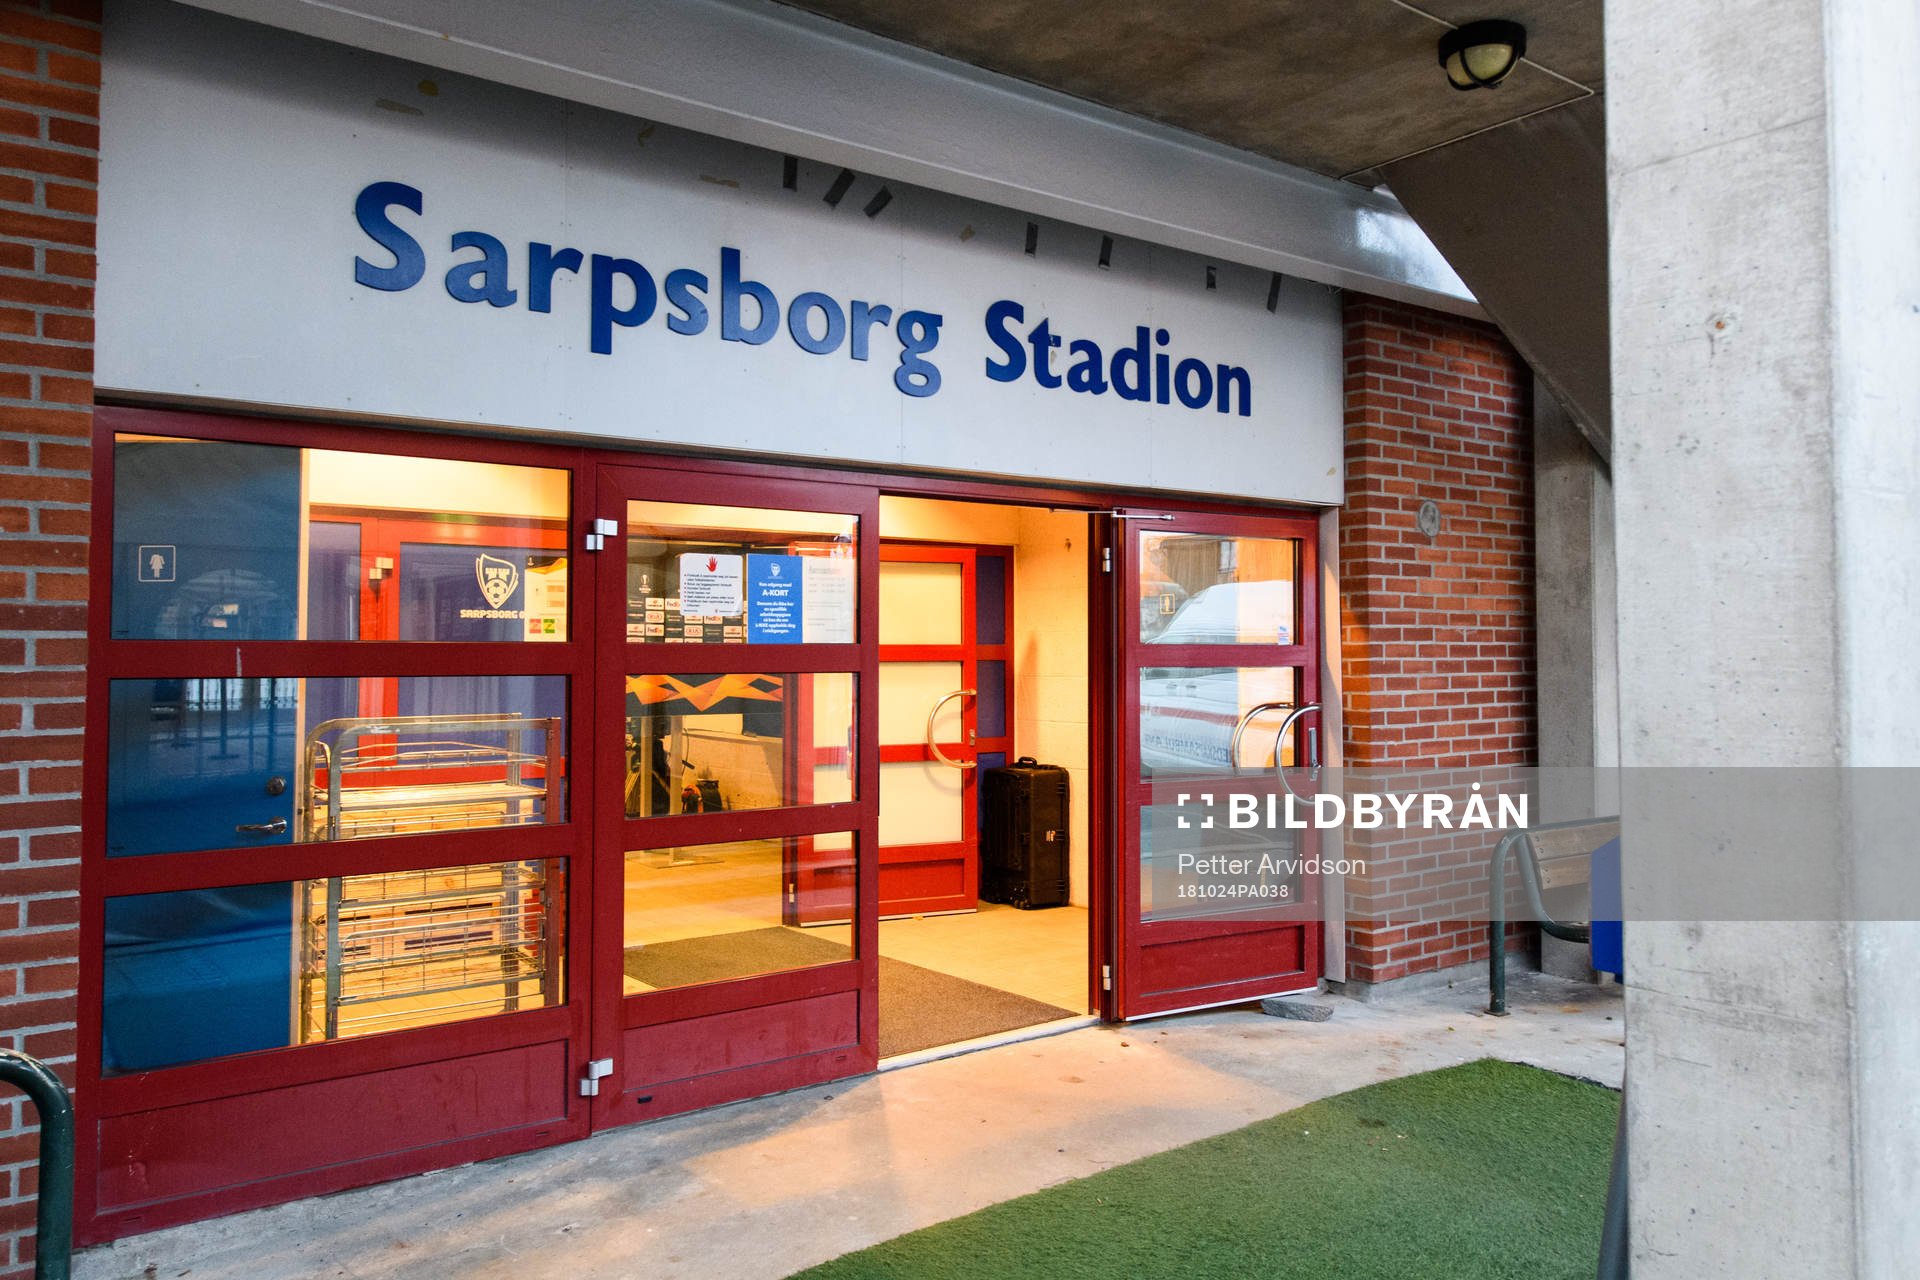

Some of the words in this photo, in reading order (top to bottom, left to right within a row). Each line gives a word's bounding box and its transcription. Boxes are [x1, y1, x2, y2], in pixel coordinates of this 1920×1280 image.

[355, 181, 943, 397] Sarpsborg
[985, 300, 1251, 416] Stadion
[460, 609, 518, 619] SARPSBORG
